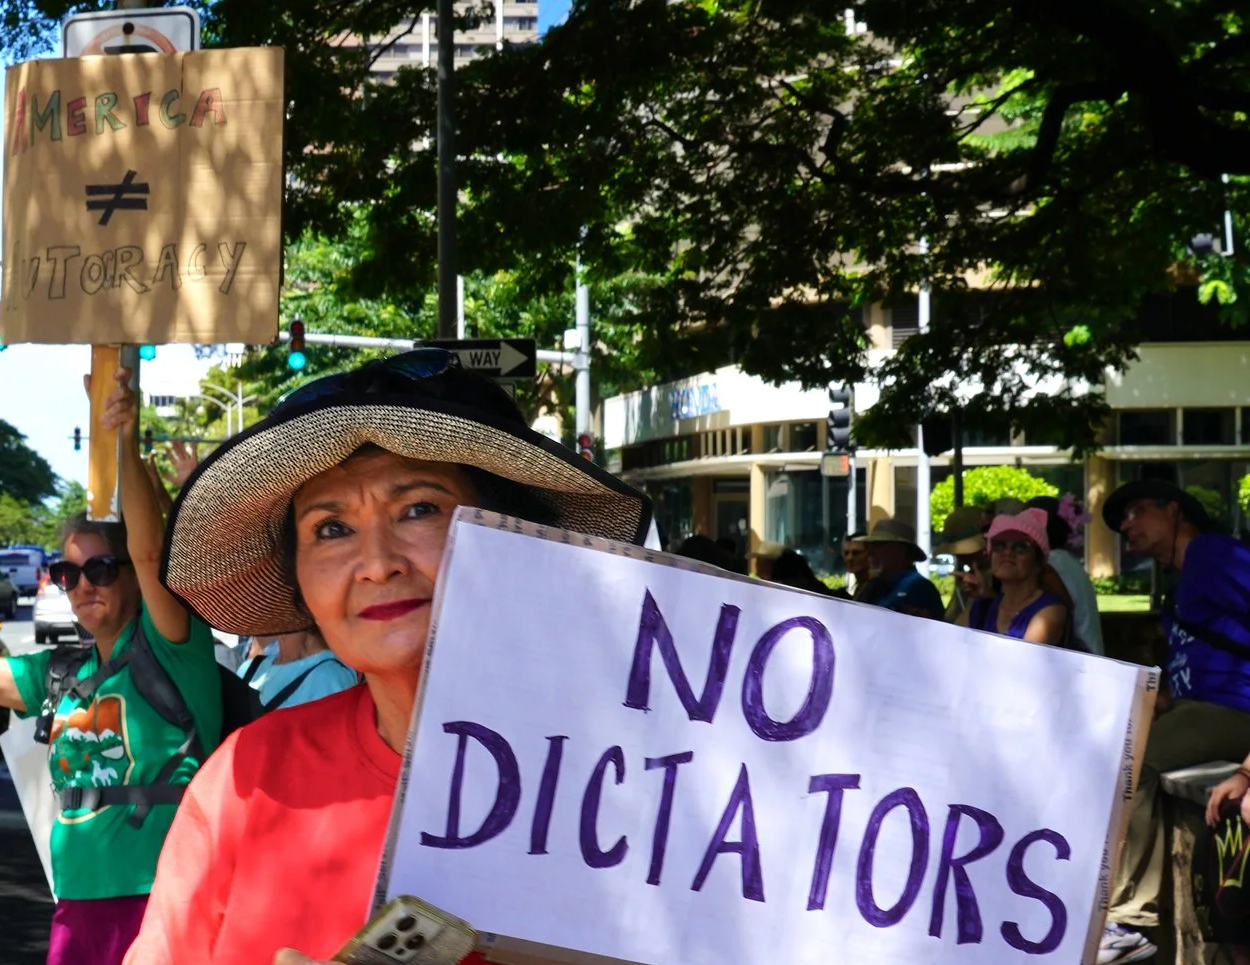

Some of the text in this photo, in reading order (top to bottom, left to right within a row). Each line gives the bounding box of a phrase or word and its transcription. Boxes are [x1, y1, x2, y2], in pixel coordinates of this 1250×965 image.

[12, 86, 228, 156] AMERICA
[469, 350, 502, 367] WAY
[623, 585, 835, 743] NO
[1122, 764, 1134, 802] Thank
[418, 719, 1072, 956] DICTATORS
